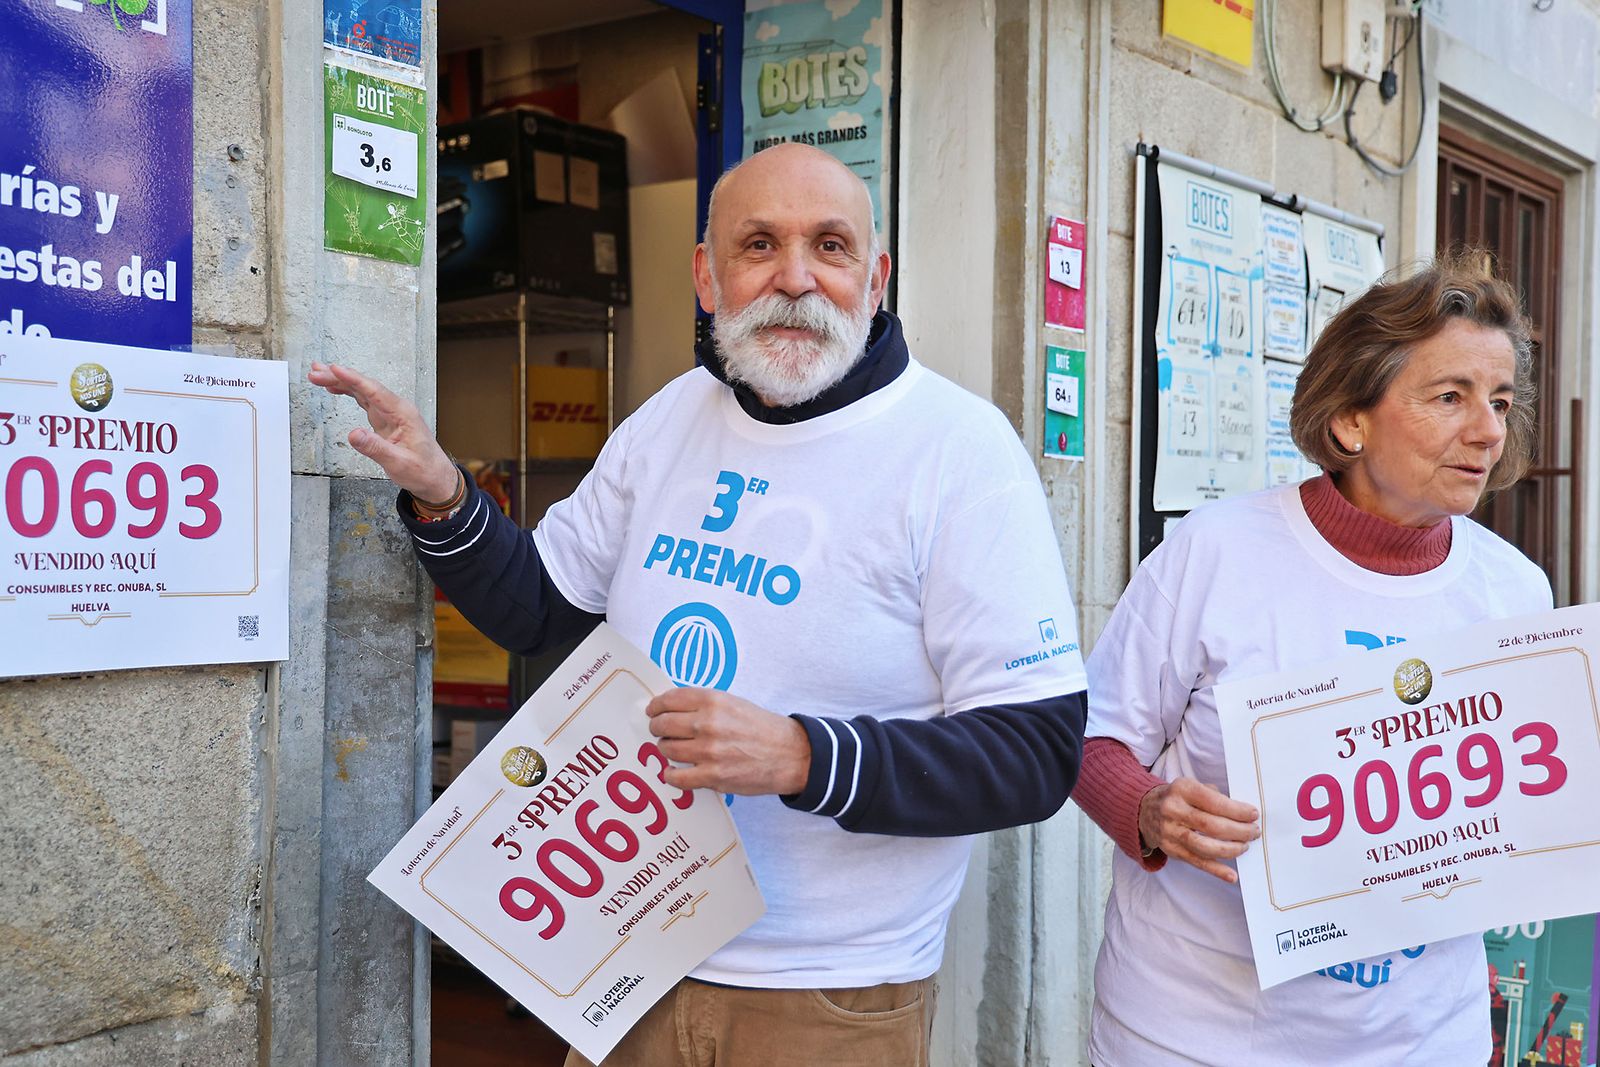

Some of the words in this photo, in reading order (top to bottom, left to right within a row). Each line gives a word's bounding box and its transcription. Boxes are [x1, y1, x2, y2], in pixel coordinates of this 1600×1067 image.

[758, 46, 870, 118] BOTES
[357, 84, 394, 115] BOTE
[817, 125, 867, 145] GRANDES
[359, 143, 392, 173] 3,6
[1, 165, 82, 217] rías
[95, 191, 120, 234] y
[1192, 188, 1229, 231] BOTES
[1057, 223, 1073, 242] BOTE
[117, 255, 177, 302] del
[1061, 260, 1071, 275] 13
[1055, 353, 1070, 371] BOTE
[183, 373, 194, 383] 22
[194, 375, 205, 385] de
[205, 376, 256, 388] Diciembre
[531, 402, 599, 423] DHL
[38, 415, 178, 454] PREMIO
[14, 552, 104, 571] VENDIDO
[110, 548, 157, 574] AQUÍ
[643, 533, 801, 606] PREMIO
[7, 584, 83, 594] CONSUMIBLES
[85, 584, 93, 593] Y
[93, 583, 116, 593] REC.
[117, 583, 154, 593] ONUBA,
[156, 582, 167, 592] SL
[71, 603, 110, 612] HUELVA
[1498, 638, 1510, 648] 22
[1511, 636, 1524, 646] de
[1524, 627, 1583, 645] Diciembre
[1005, 650, 1050, 670] LOTERÍA
[563, 688, 575, 700] 22
[572, 682, 583, 692] de
[578, 651, 613, 685] Diciembre
[1285, 690, 1297, 700] de
[1371, 691, 1503, 748] PREMIO
[517, 735, 619, 831] PREMIO
[1296, 722, 1568, 848] 90693
[426, 838, 437, 849] de
[499, 741, 694, 940] 90693
[1366, 830, 1448, 864] VENDIDO
[1453, 812, 1501, 843] AQUÍ
[599, 862, 661, 917] VENDIDO
[657, 831, 691, 867] AQUÍ
[1362, 863, 1431, 887] CONSUMIBLES
[1433, 860, 1440, 870] Y
[1441, 855, 1462, 867] REC.
[1463, 846, 1502, 861] ONUBA,
[1503, 842, 1516, 853] SL
[617, 891, 665, 936] CONSUMIBLES
[661, 887, 670, 895] Y
[700, 854, 709, 864] SL
[1422, 873, 1459, 890] HUELVA
[666, 892, 693, 915] HUELVA
[1297, 922, 1337, 938] LOTERÍA
[1299, 929, 1348, 948] NACIONAL
[1314, 958, 1392, 988] QUÍ
[600, 975, 631, 1005] LOTERÍA
[607, 974, 645, 1010] NACIONAL
